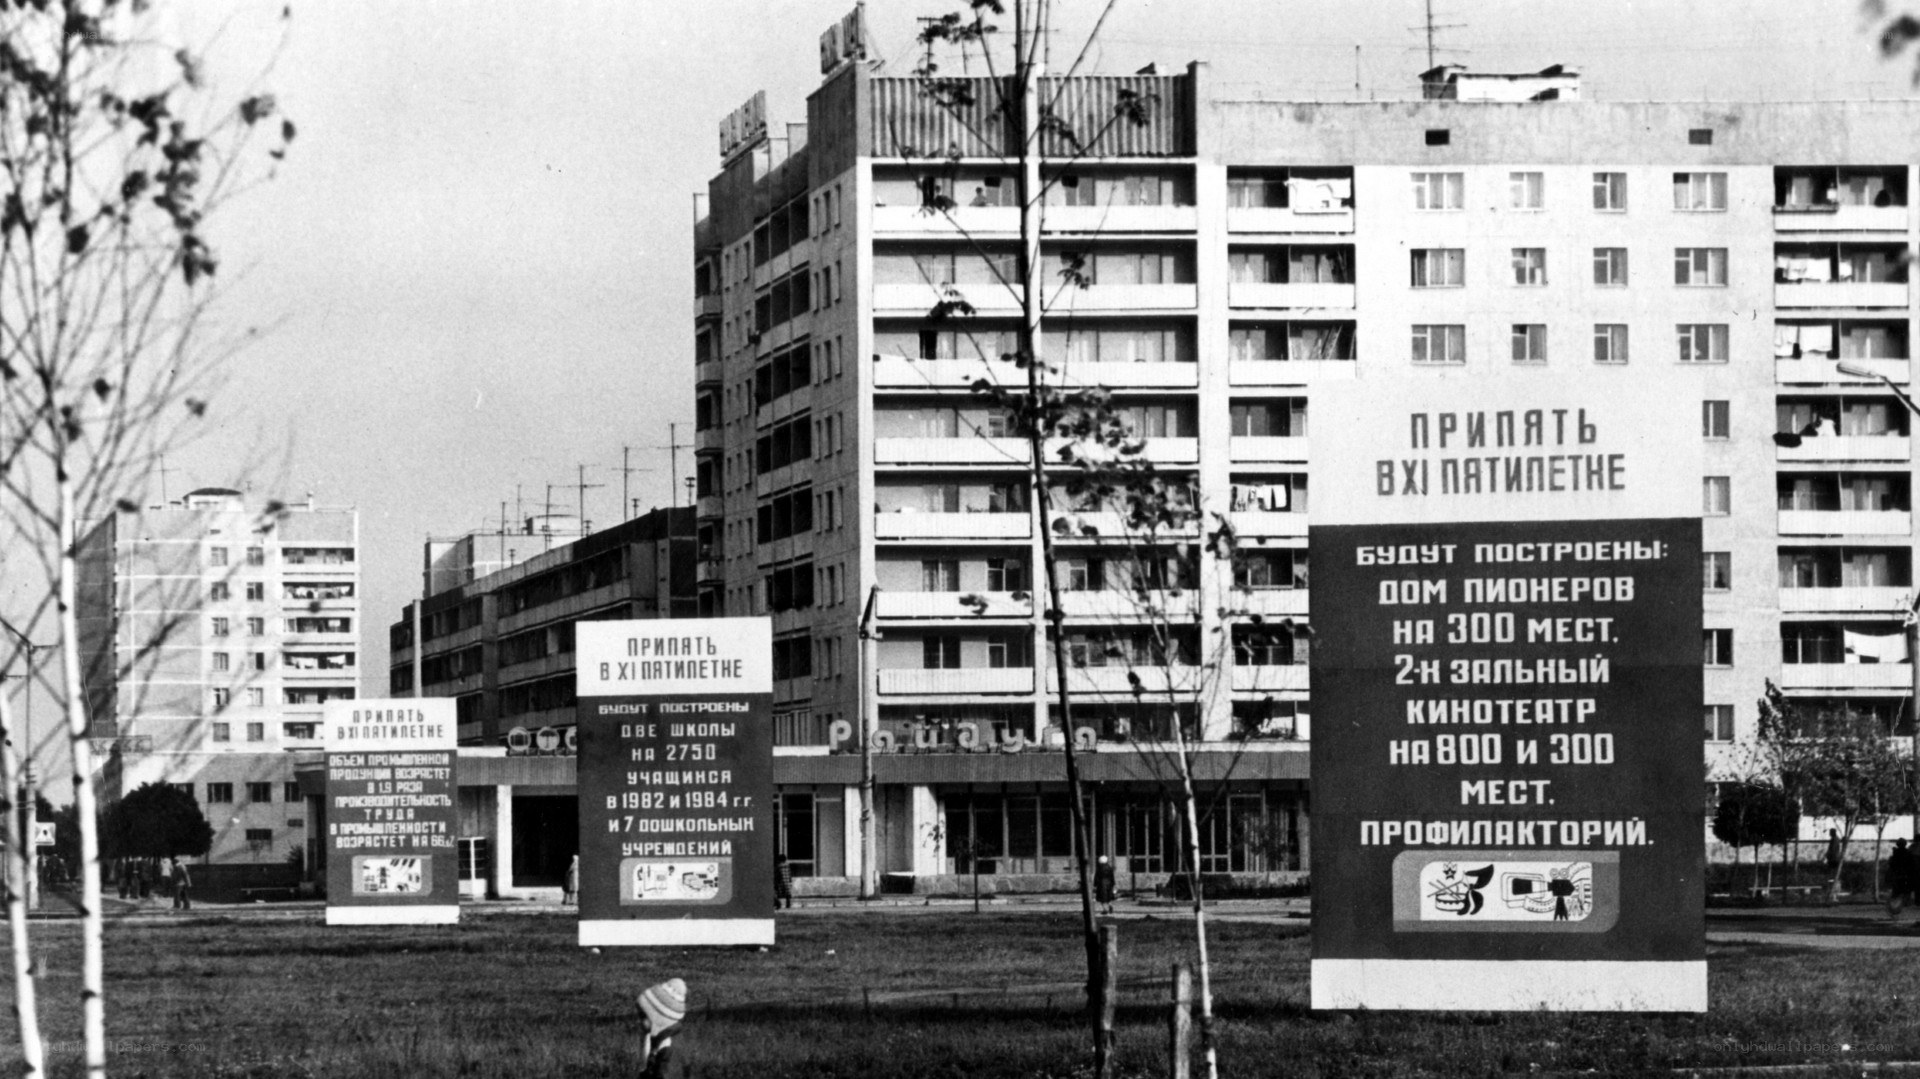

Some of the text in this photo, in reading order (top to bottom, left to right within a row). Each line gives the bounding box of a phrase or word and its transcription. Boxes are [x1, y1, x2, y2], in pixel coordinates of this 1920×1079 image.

[1410, 408, 1597, 449] ПРИПЯТЬ
[1376, 459, 1395, 496] В
[1356, 540, 1669, 565] БУДУТ ПОСТРОЕНЫ:
[1378, 576, 1635, 605] ДОМ ПИОНЕРОВ
[1393, 612, 1619, 645] НА 300 МЕСТ.
[627, 636, 717, 656] ПРИПЯТЬ
[600, 662, 610, 681] В
[1450, 653, 1610, 684] ЗАЛЬНЫЙ
[353, 709, 424, 723] ПРИПЯТЬ
[598, 702, 749, 715] БУДУТ ПОСТРОЕНЫ
[1406, 698, 1596, 725] КИНОТЕАТР
[621, 723, 735, 738] ДВЕ ШКОЛЫ
[632, 743, 716, 761] НА 2750
[1390, 733, 1615, 765] НА 800 И 300
[335, 794, 452, 808] ПРОИЗВОДИТЕЛЬНОСТЬ
[622, 792, 665, 809] 1982
[685, 791, 728, 808] 1984
[1461, 779, 1555, 805] МЕСТ.
[364, 808, 414, 820] ТРУДА
[623, 815, 634, 832] 7
[330, 821, 446, 835] В ПРОМЫШЛЕННОСТИ
[1360, 816, 1655, 846] ПРОФИЛАКТОРИЙ.
[336, 835, 406, 848] ВОЗРАСТЕТ
[412, 835, 428, 847] НА
[622, 839, 732, 856] УЧРЕЖДЕНИЙ
